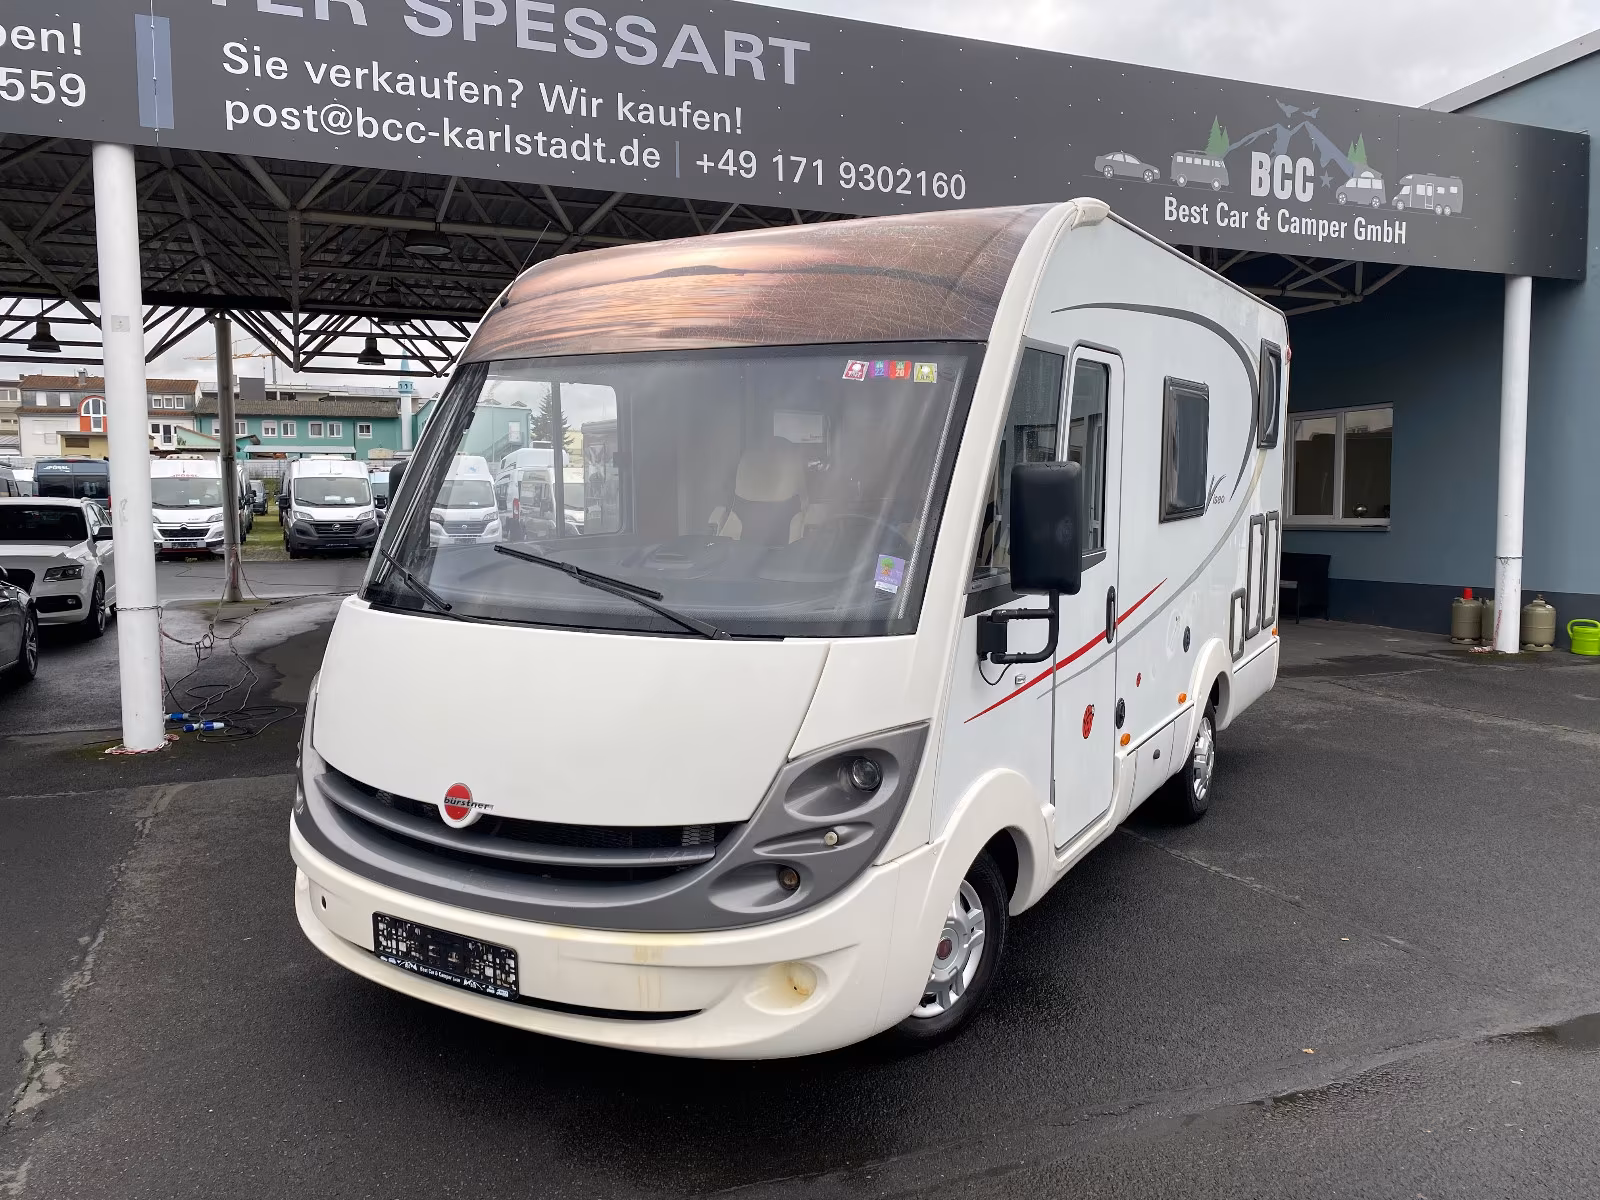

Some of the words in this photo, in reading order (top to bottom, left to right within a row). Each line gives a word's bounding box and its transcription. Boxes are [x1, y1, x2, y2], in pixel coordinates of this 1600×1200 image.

[0, 22, 81, 56] en!
[404, 0, 811, 85] SPESSART
[0, 66, 86, 108] 559
[222, 41, 288, 80] Sie
[303, 60, 524, 107] verkaufen?
[538, 82, 604, 118] Wir
[617, 92, 743, 133] kaufen!
[225, 99, 661, 169] post@bcc-karlstadt.de
[696, 148, 757, 179] +49
[772, 154, 823, 186] 171
[839, 161, 967, 200] 9302160
[1250, 151, 1315, 203] BCC
[1164, 196, 1210, 226] Best
[1216, 201, 1249, 230] Car
[1256, 206, 1271, 231] &
[1277, 208, 1348, 242] Camper
[1353, 216, 1407, 245] GmbH
[443, 795, 489, 810] bürstner
